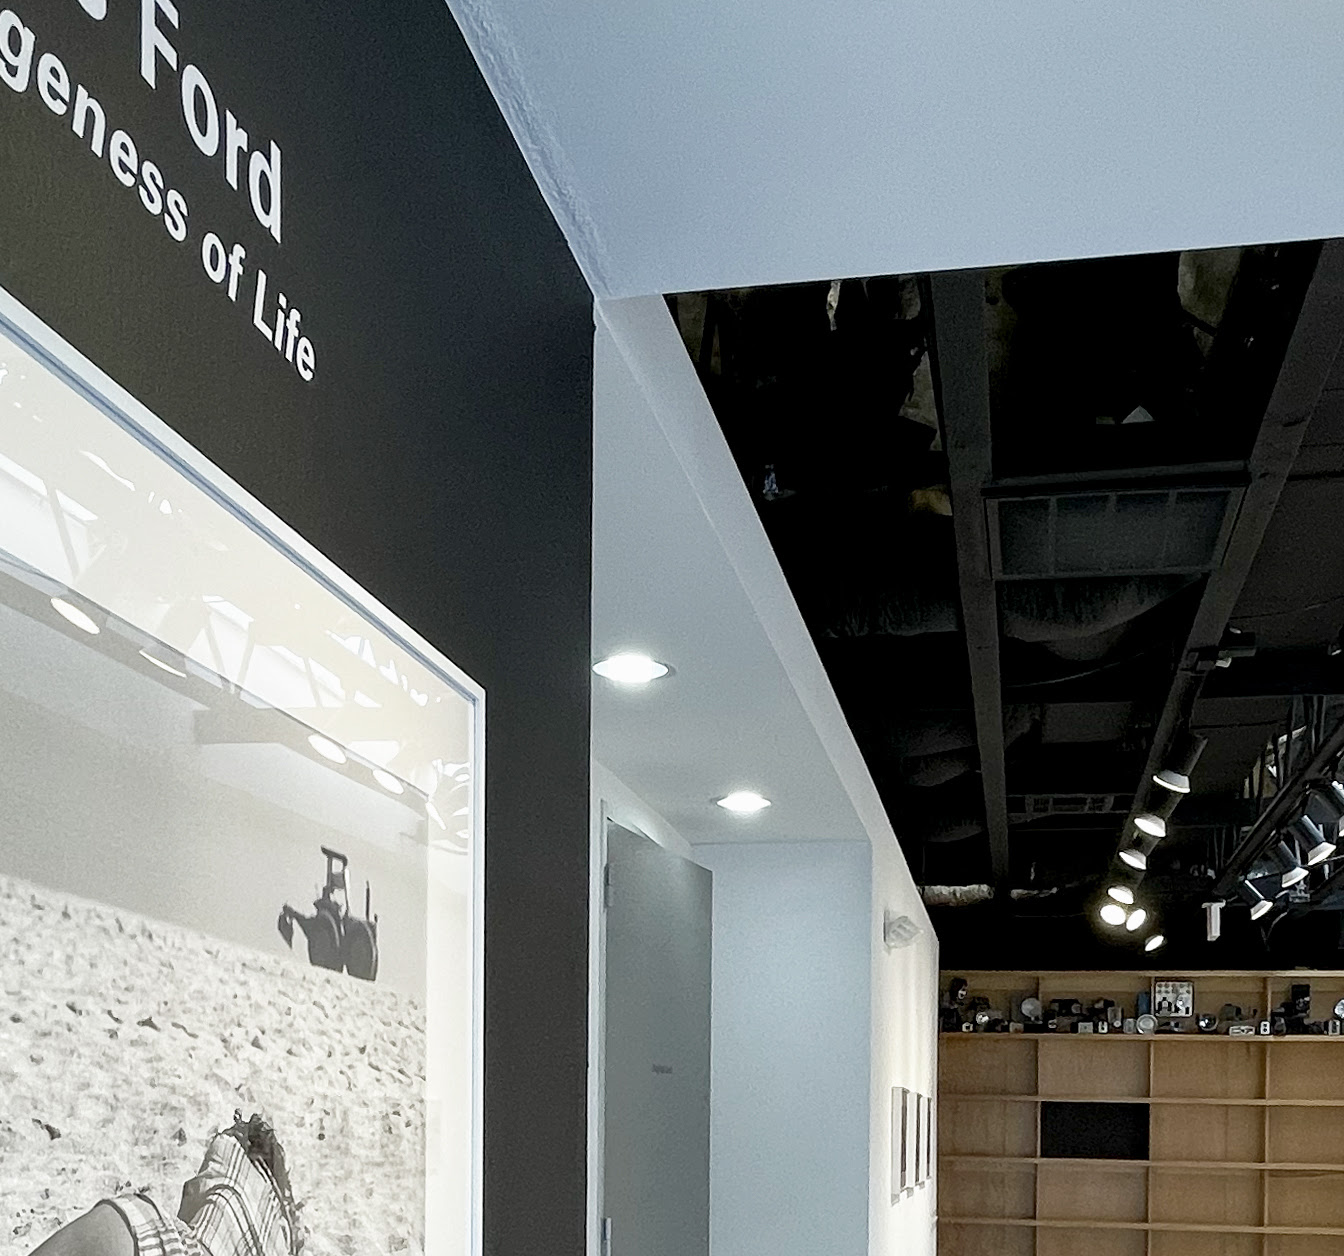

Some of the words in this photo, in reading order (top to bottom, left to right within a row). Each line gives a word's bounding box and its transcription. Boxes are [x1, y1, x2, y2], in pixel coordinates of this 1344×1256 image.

[140, 0, 282, 244] Ford
[201, 232, 246, 302] of
[253, 269, 316, 382] Life
